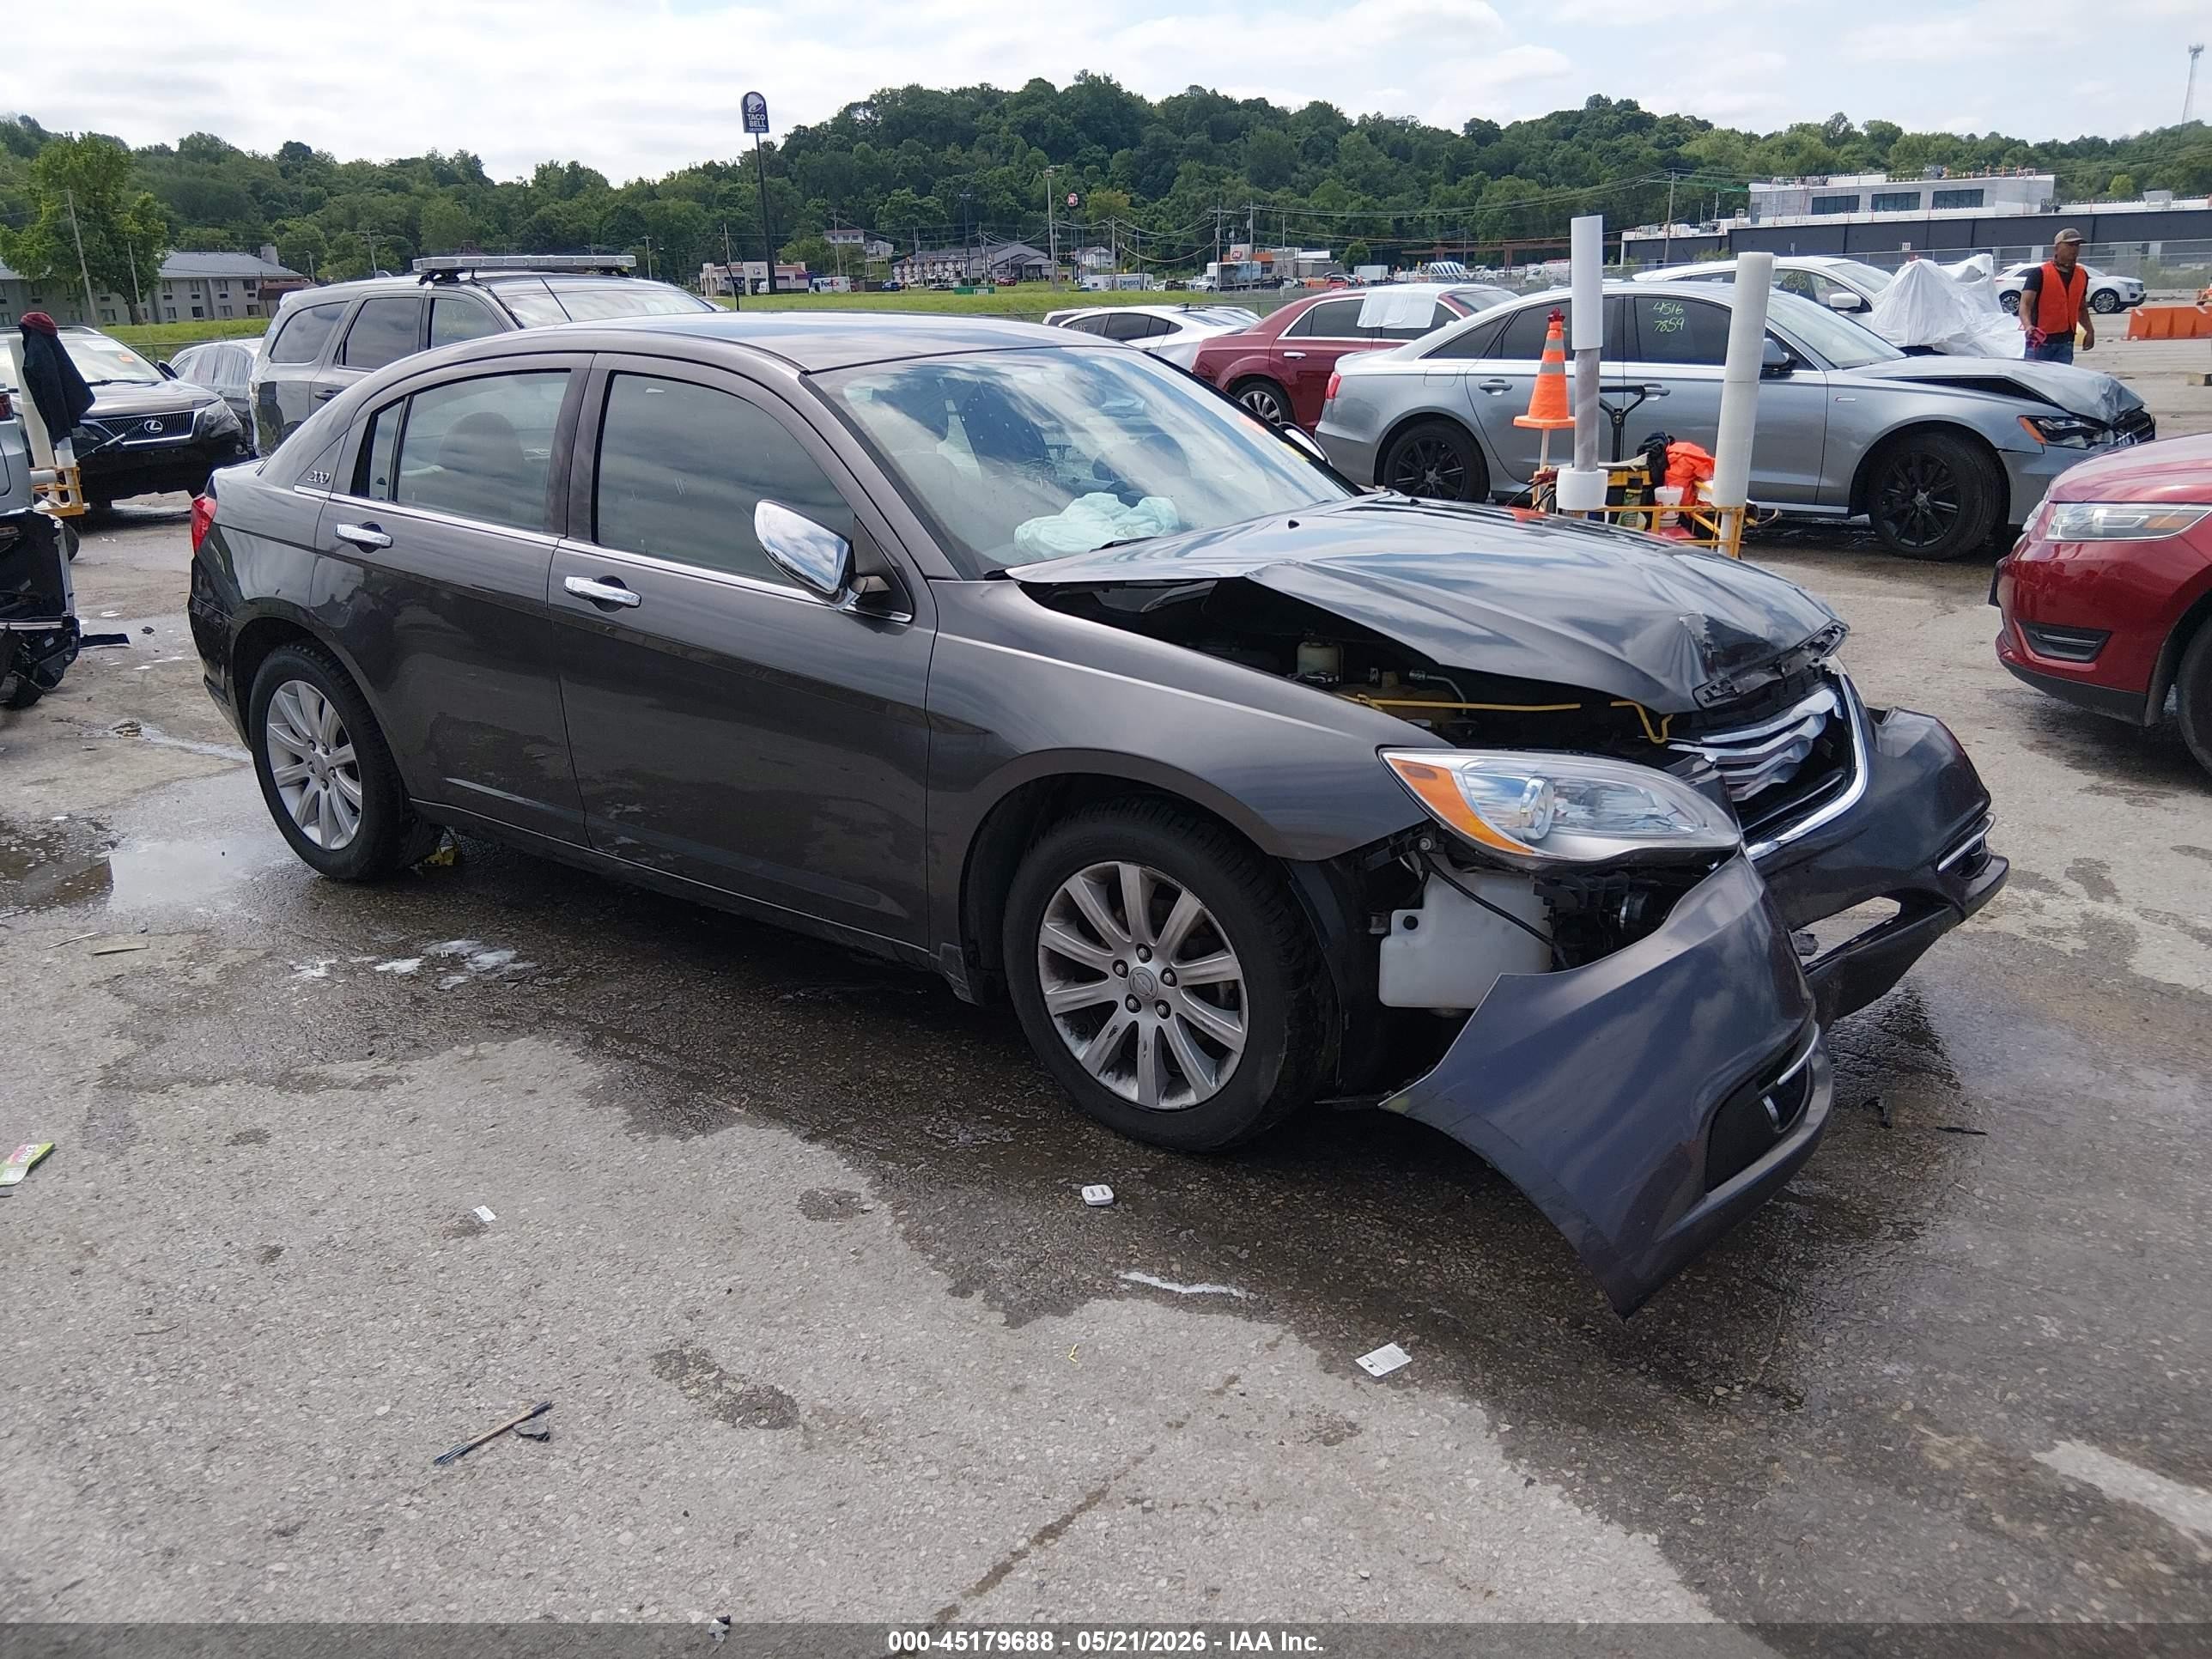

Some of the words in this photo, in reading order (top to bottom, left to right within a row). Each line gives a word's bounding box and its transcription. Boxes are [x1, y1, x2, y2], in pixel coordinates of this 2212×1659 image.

[1653, 301, 1684, 315] 4516
[1654, 317, 1685, 332] 7859
[307, 470, 330, 484] 200
